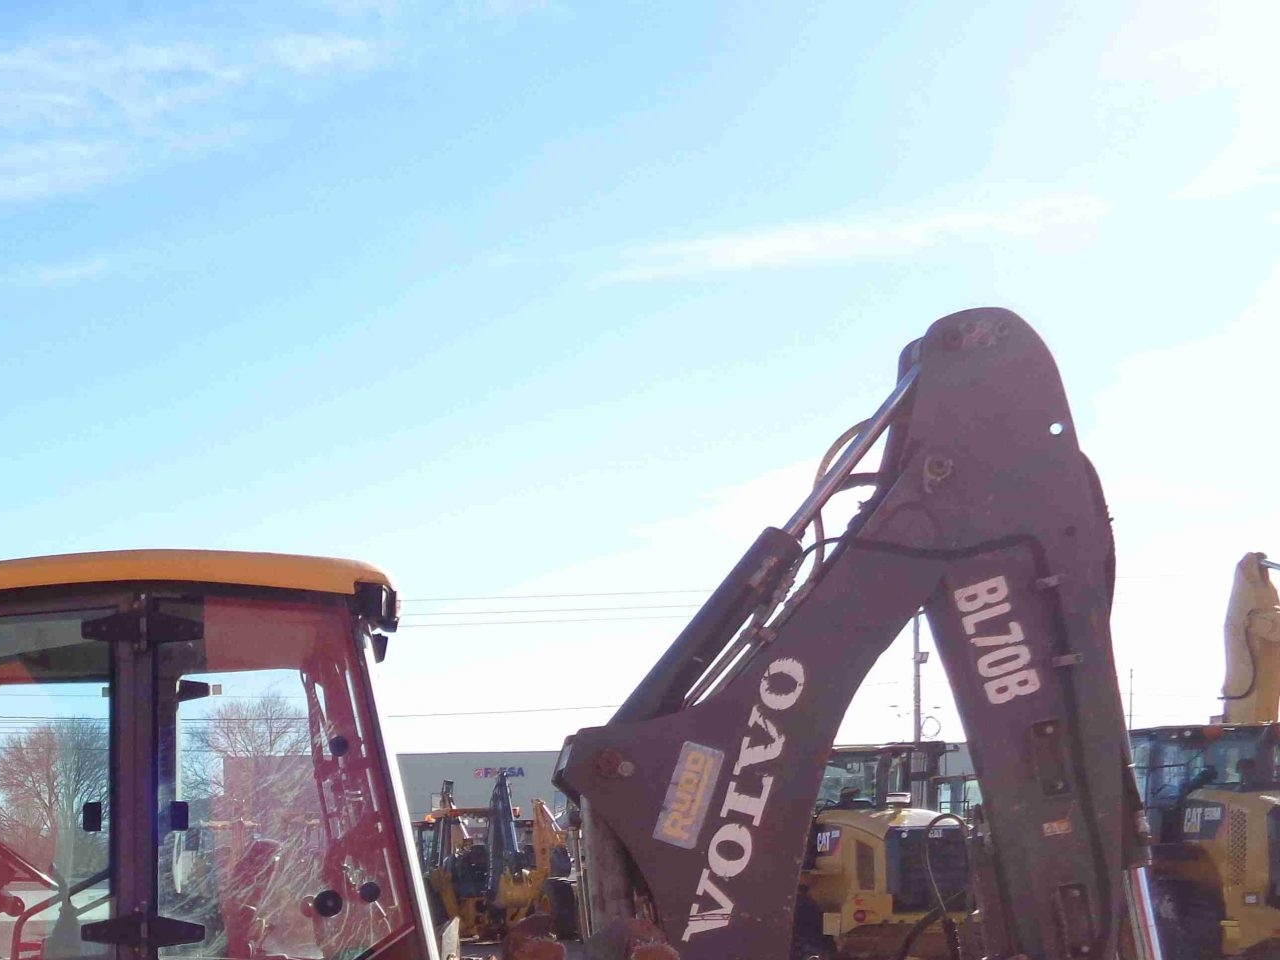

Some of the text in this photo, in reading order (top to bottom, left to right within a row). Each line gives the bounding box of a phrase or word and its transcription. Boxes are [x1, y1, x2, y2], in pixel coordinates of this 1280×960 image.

[954, 575, 1040, 704] BL70B
[681, 657, 805, 942] VOLVO
[1183, 807, 1202, 833] CAT
[817, 831, 831, 852] CAT
